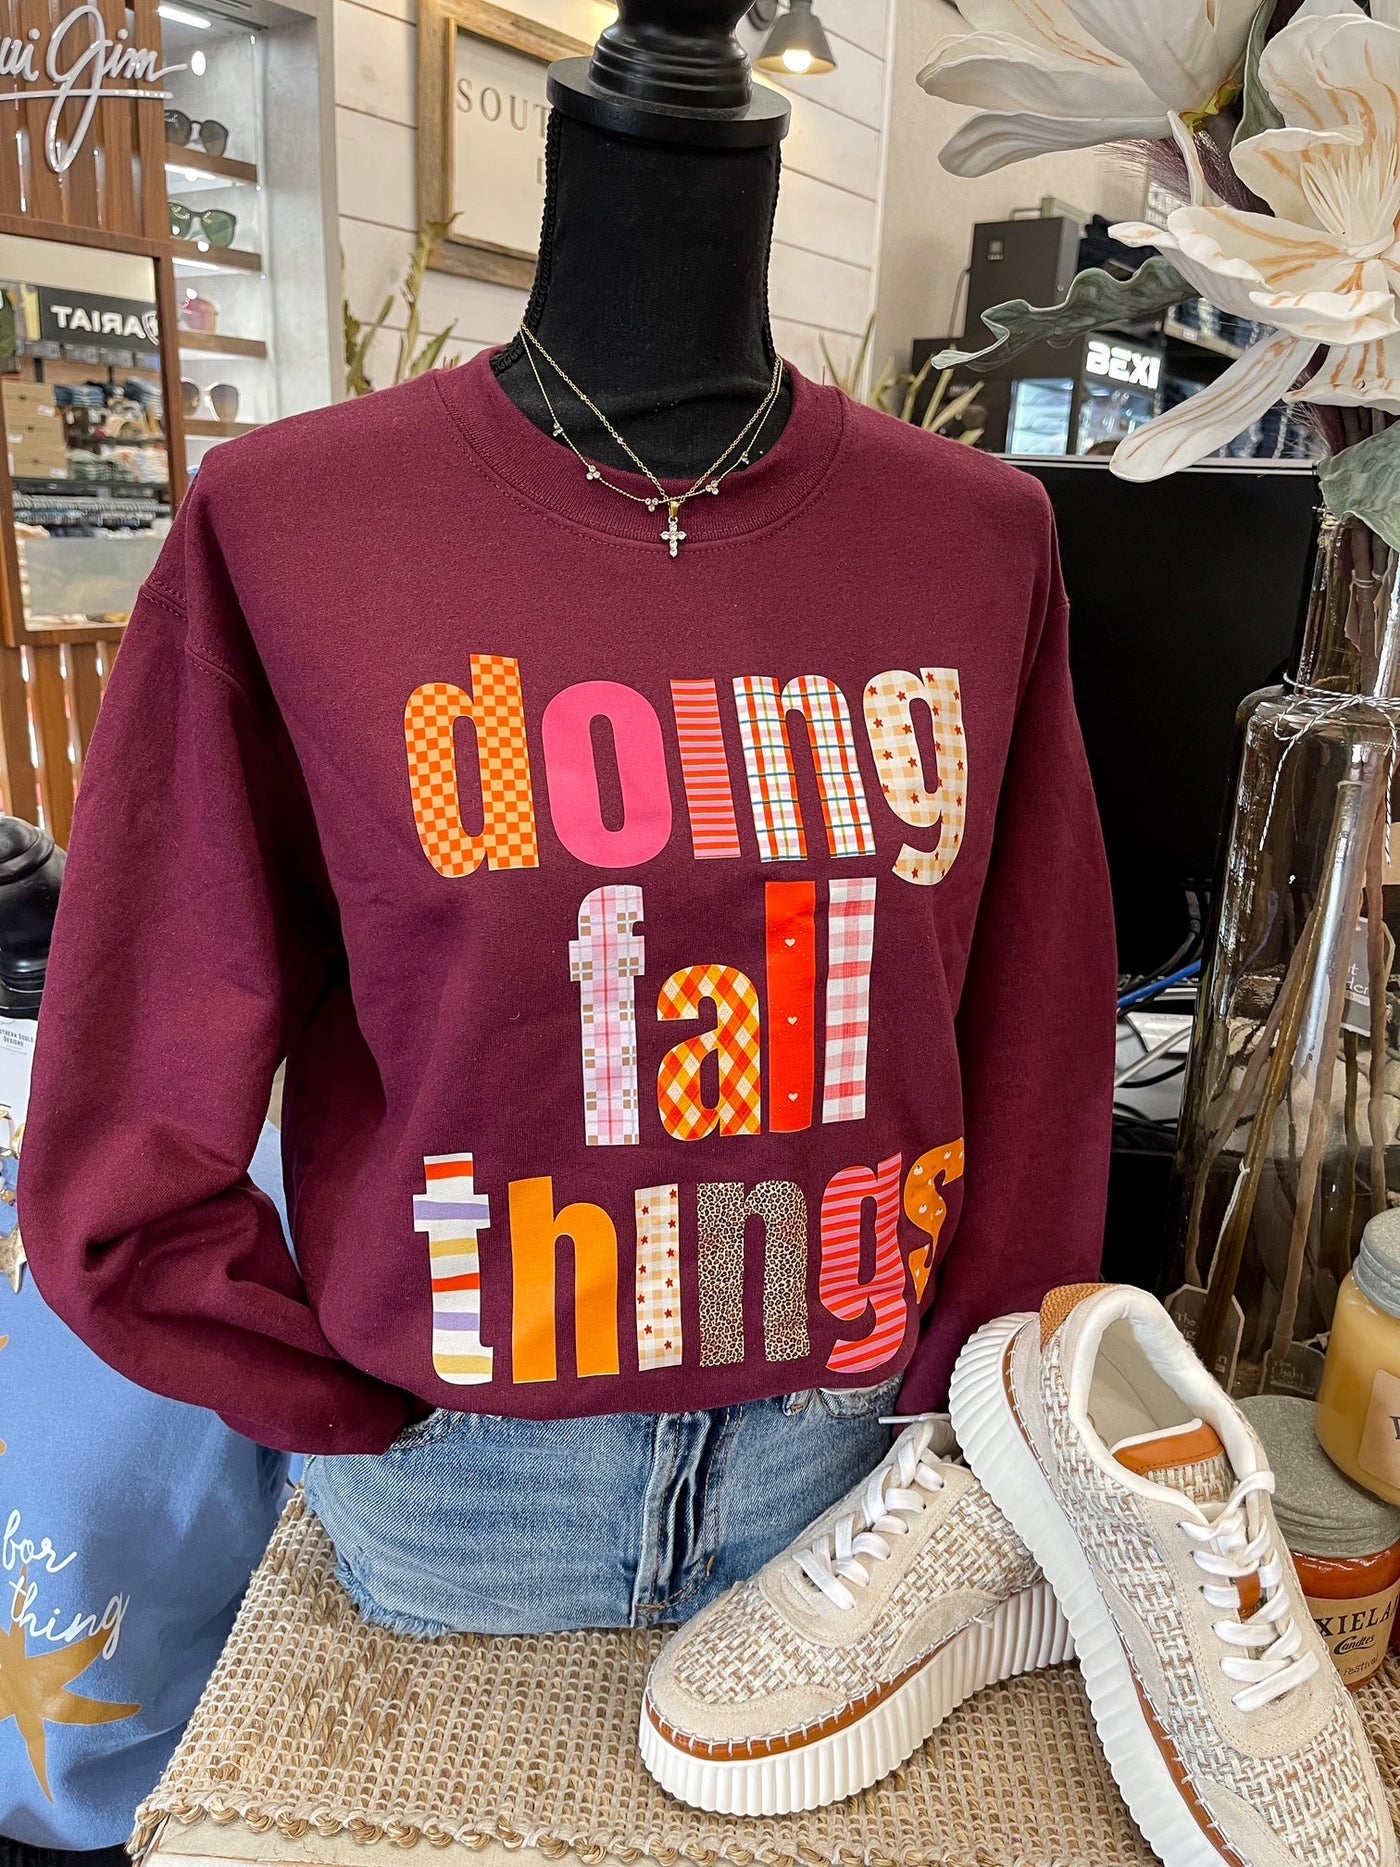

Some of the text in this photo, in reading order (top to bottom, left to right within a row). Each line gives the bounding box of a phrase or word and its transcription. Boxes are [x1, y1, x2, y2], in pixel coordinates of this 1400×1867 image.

[0, 5, 188, 173] ui Jim
[456, 78, 549, 139] SOUT
[404, 653, 968, 886] doing
[568, 877, 878, 1147] fall
[413, 1136, 966, 1385] things
[2, 1508, 77, 1573] for
[9, 1575, 130, 1660] thing
[1313, 1594, 1399, 1637] XIELA
[1334, 1635, 1377, 1655] Candles
